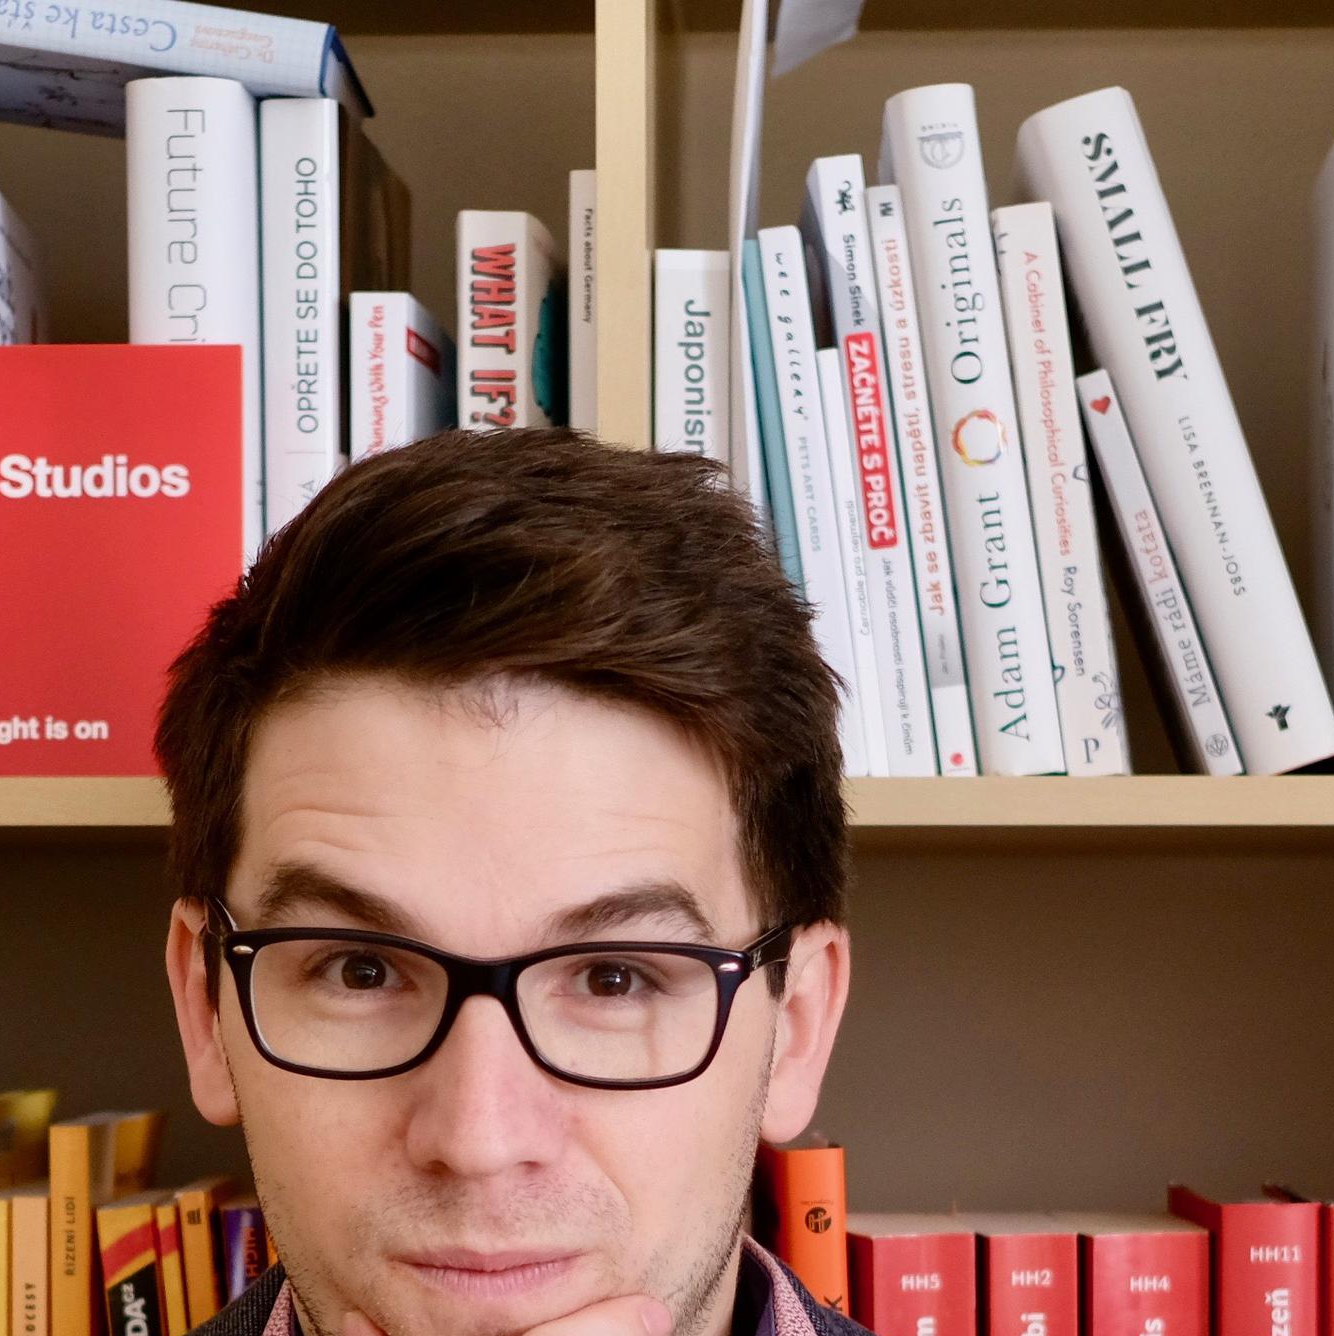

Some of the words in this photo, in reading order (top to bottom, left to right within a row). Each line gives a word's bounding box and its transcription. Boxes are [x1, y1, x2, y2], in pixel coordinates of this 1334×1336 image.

[295, 156, 318, 233] TOHO
[295, 246, 318, 279] DO
[842, 234, 858, 282] Simon
[1081, 131, 1153, 291] SMALL
[1134, 298, 1190, 383] FRY
[296, 289, 318, 320] SE
[847, 285, 865, 327] Sinek
[932, 197, 986, 386] Originals
[293, 331, 318, 437] OPŘETE
[1177, 416, 1197, 454] LISA
[1193, 460, 1247, 598] BRENNAN-JOBS
[978, 490, 1012, 610] Grant
[994, 624, 1031, 742] Adam
[45, 716, 67, 740] is
[75, 721, 108, 740] on
[1249, 1246, 1301, 1263] HH11
[901, 1274, 942, 1291] HH5
[1011, 1269, 1052, 1288] HH2
[1129, 1275, 1171, 1293] HH4
